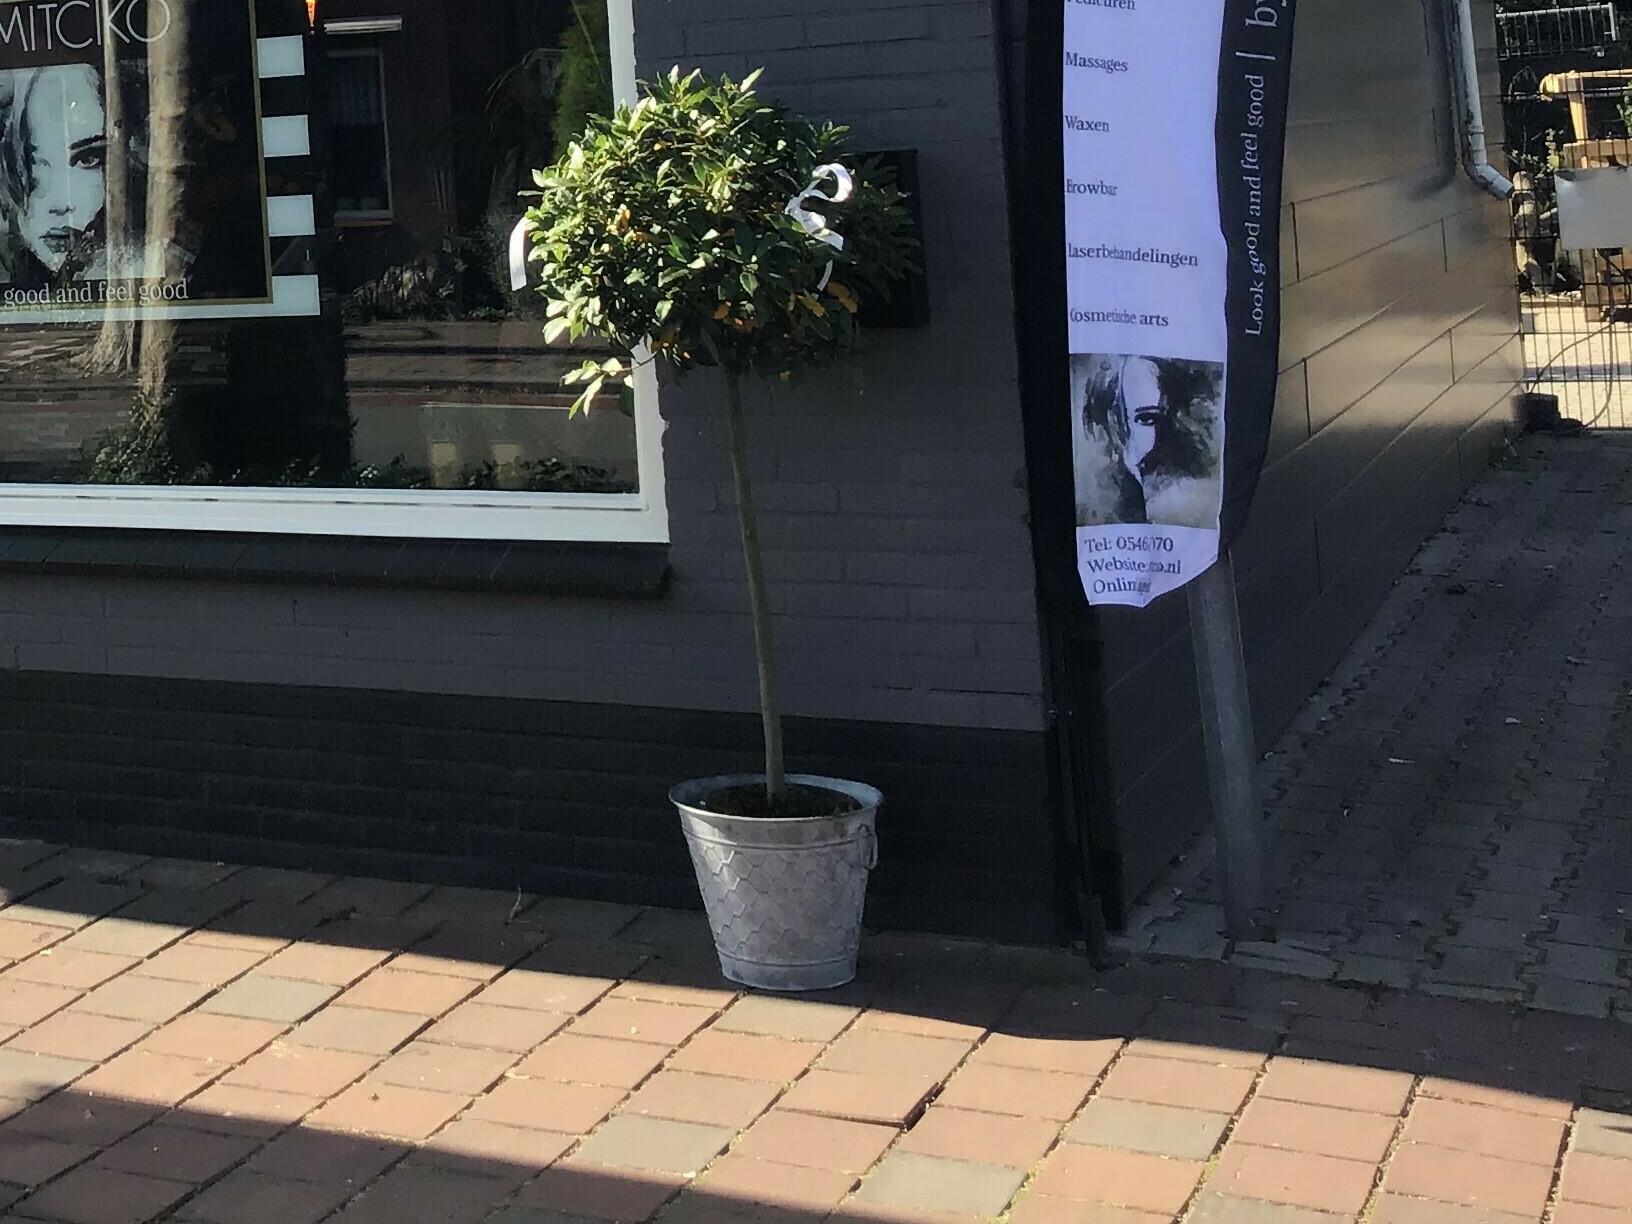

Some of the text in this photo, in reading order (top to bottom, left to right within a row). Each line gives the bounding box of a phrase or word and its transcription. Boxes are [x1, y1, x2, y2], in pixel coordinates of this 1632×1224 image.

[1065, 51, 1129, 74] Massages
[1065, 114, 1110, 133] Waxen
[1240, 74, 1266, 336] Look good and feel good
[3, 282, 50, 309] good
[56, 281, 92, 303] and
[98, 279, 133, 302] feel
[138, 278, 189, 306] good
[1139, 313, 1170, 327] arts
[1085, 538, 1113, 553] Tel:
